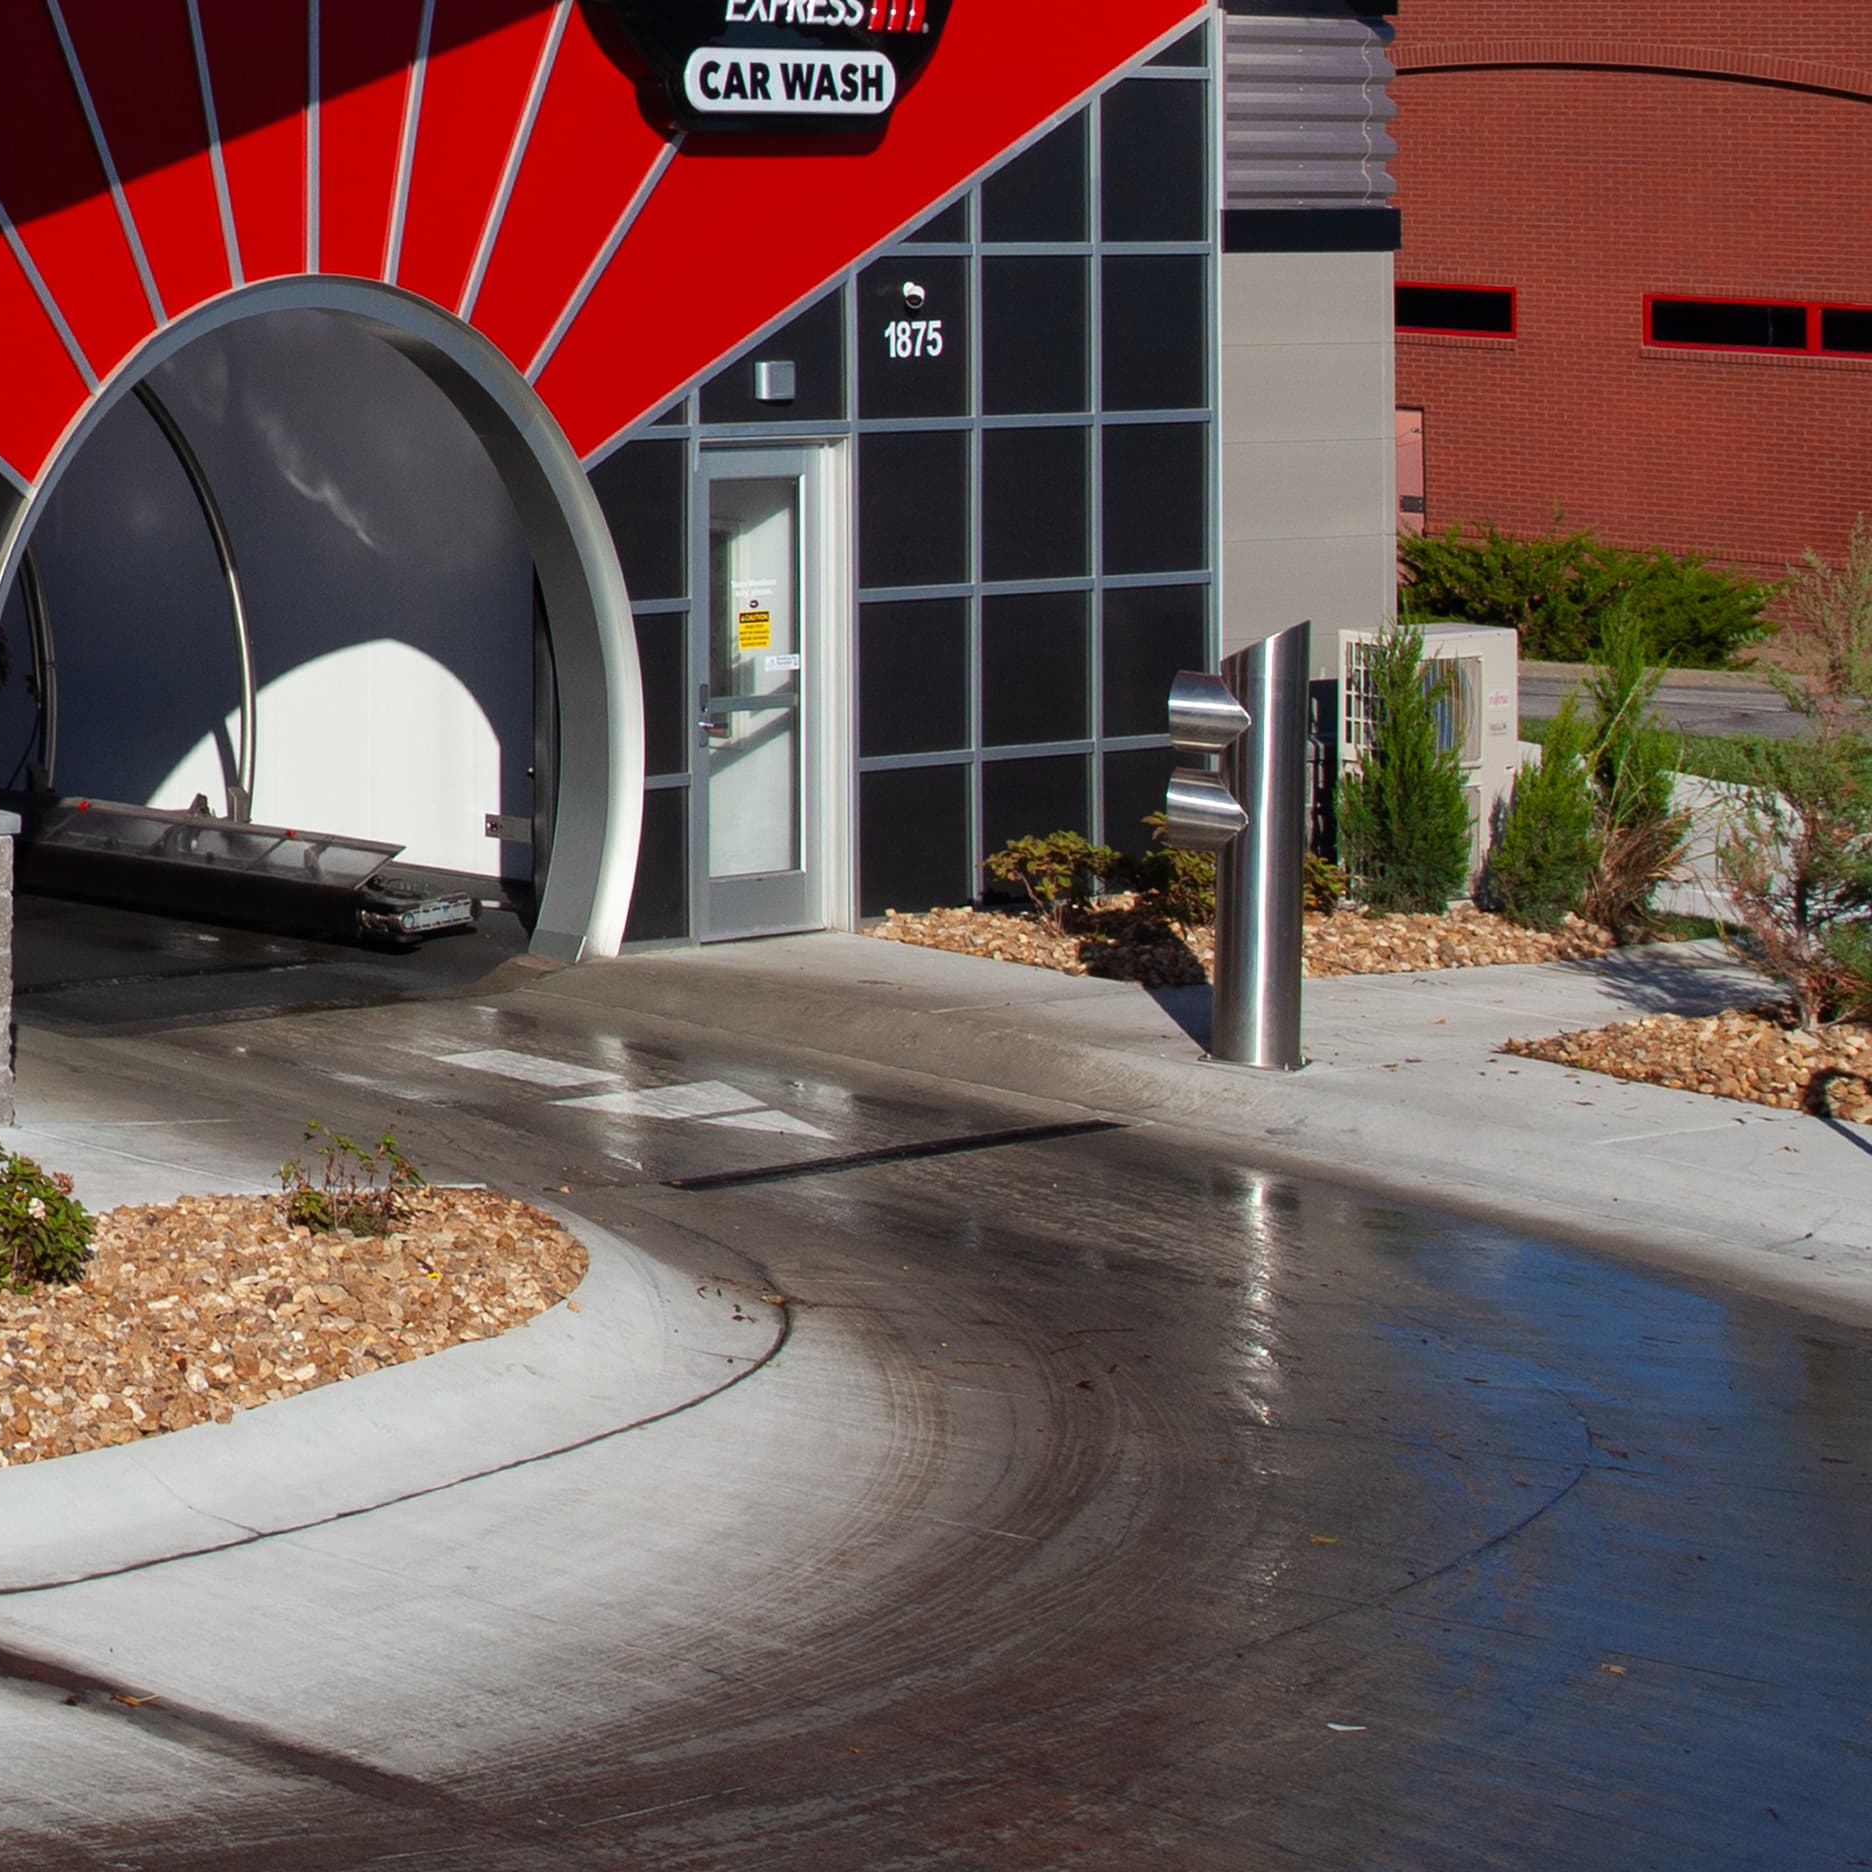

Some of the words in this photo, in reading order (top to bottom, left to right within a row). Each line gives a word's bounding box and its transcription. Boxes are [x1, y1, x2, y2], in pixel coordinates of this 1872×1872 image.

[699, 61, 771, 100] CAR
[779, 63, 884, 101] WASH
[884, 319, 943, 358] 1875
